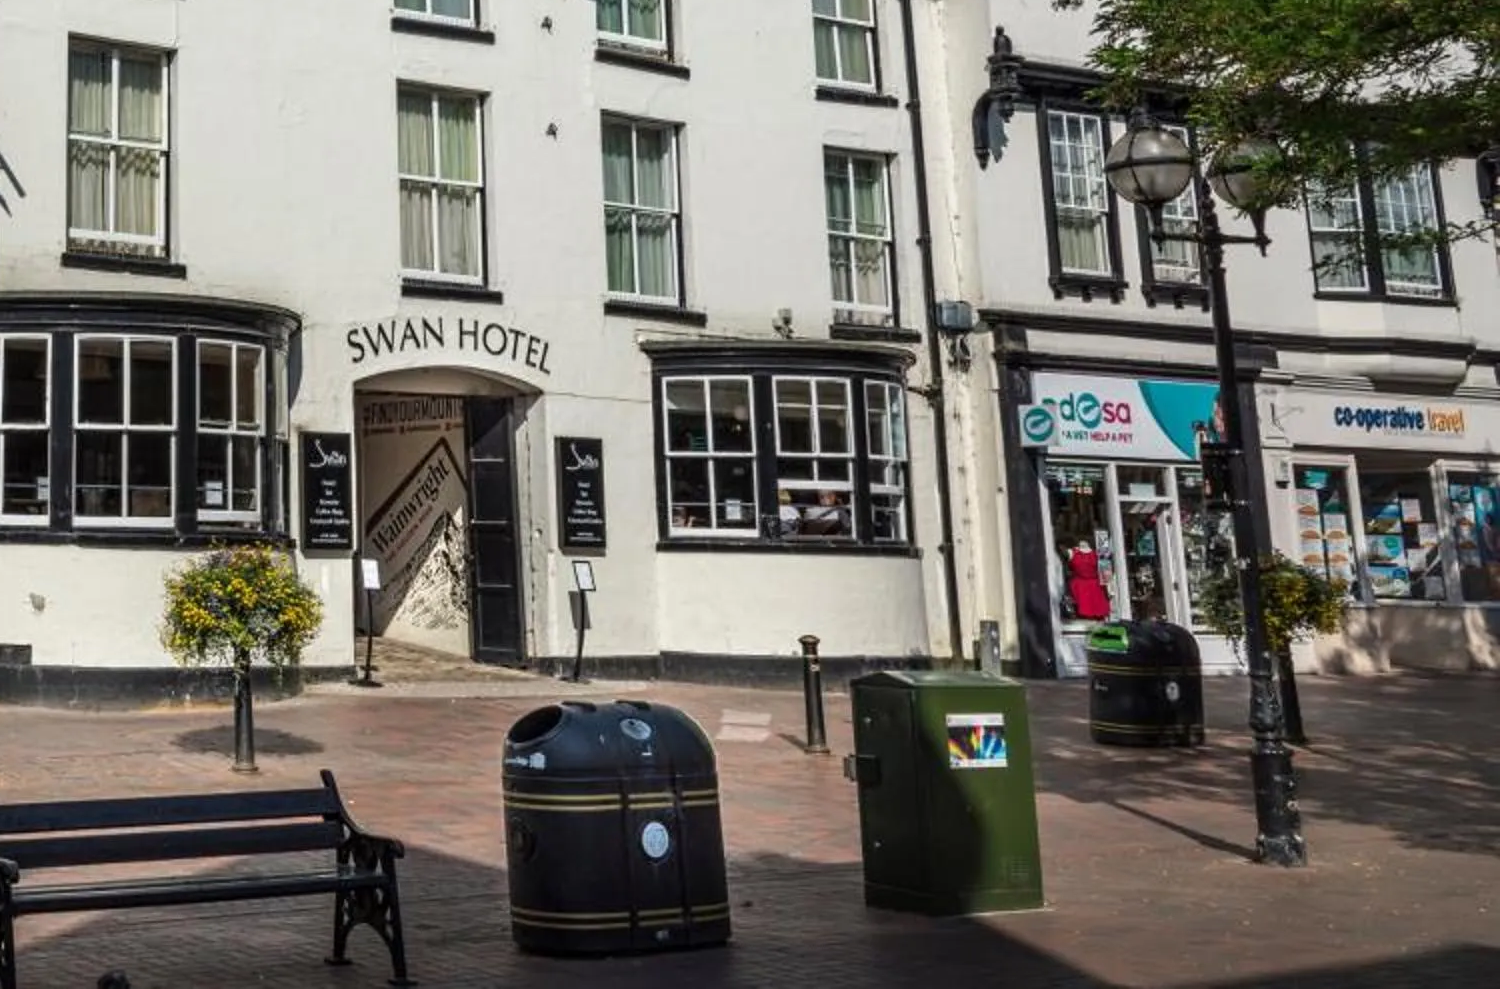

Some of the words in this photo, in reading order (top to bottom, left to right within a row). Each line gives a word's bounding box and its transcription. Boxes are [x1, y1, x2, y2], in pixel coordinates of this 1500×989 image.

[347, 317, 445, 363] SWAN
[458, 317, 551, 376] HOTEL
[1334, 406, 1424, 433] co-operative
[1427, 407, 1465, 433] travel
[372, 457, 449, 553] Wainwright
